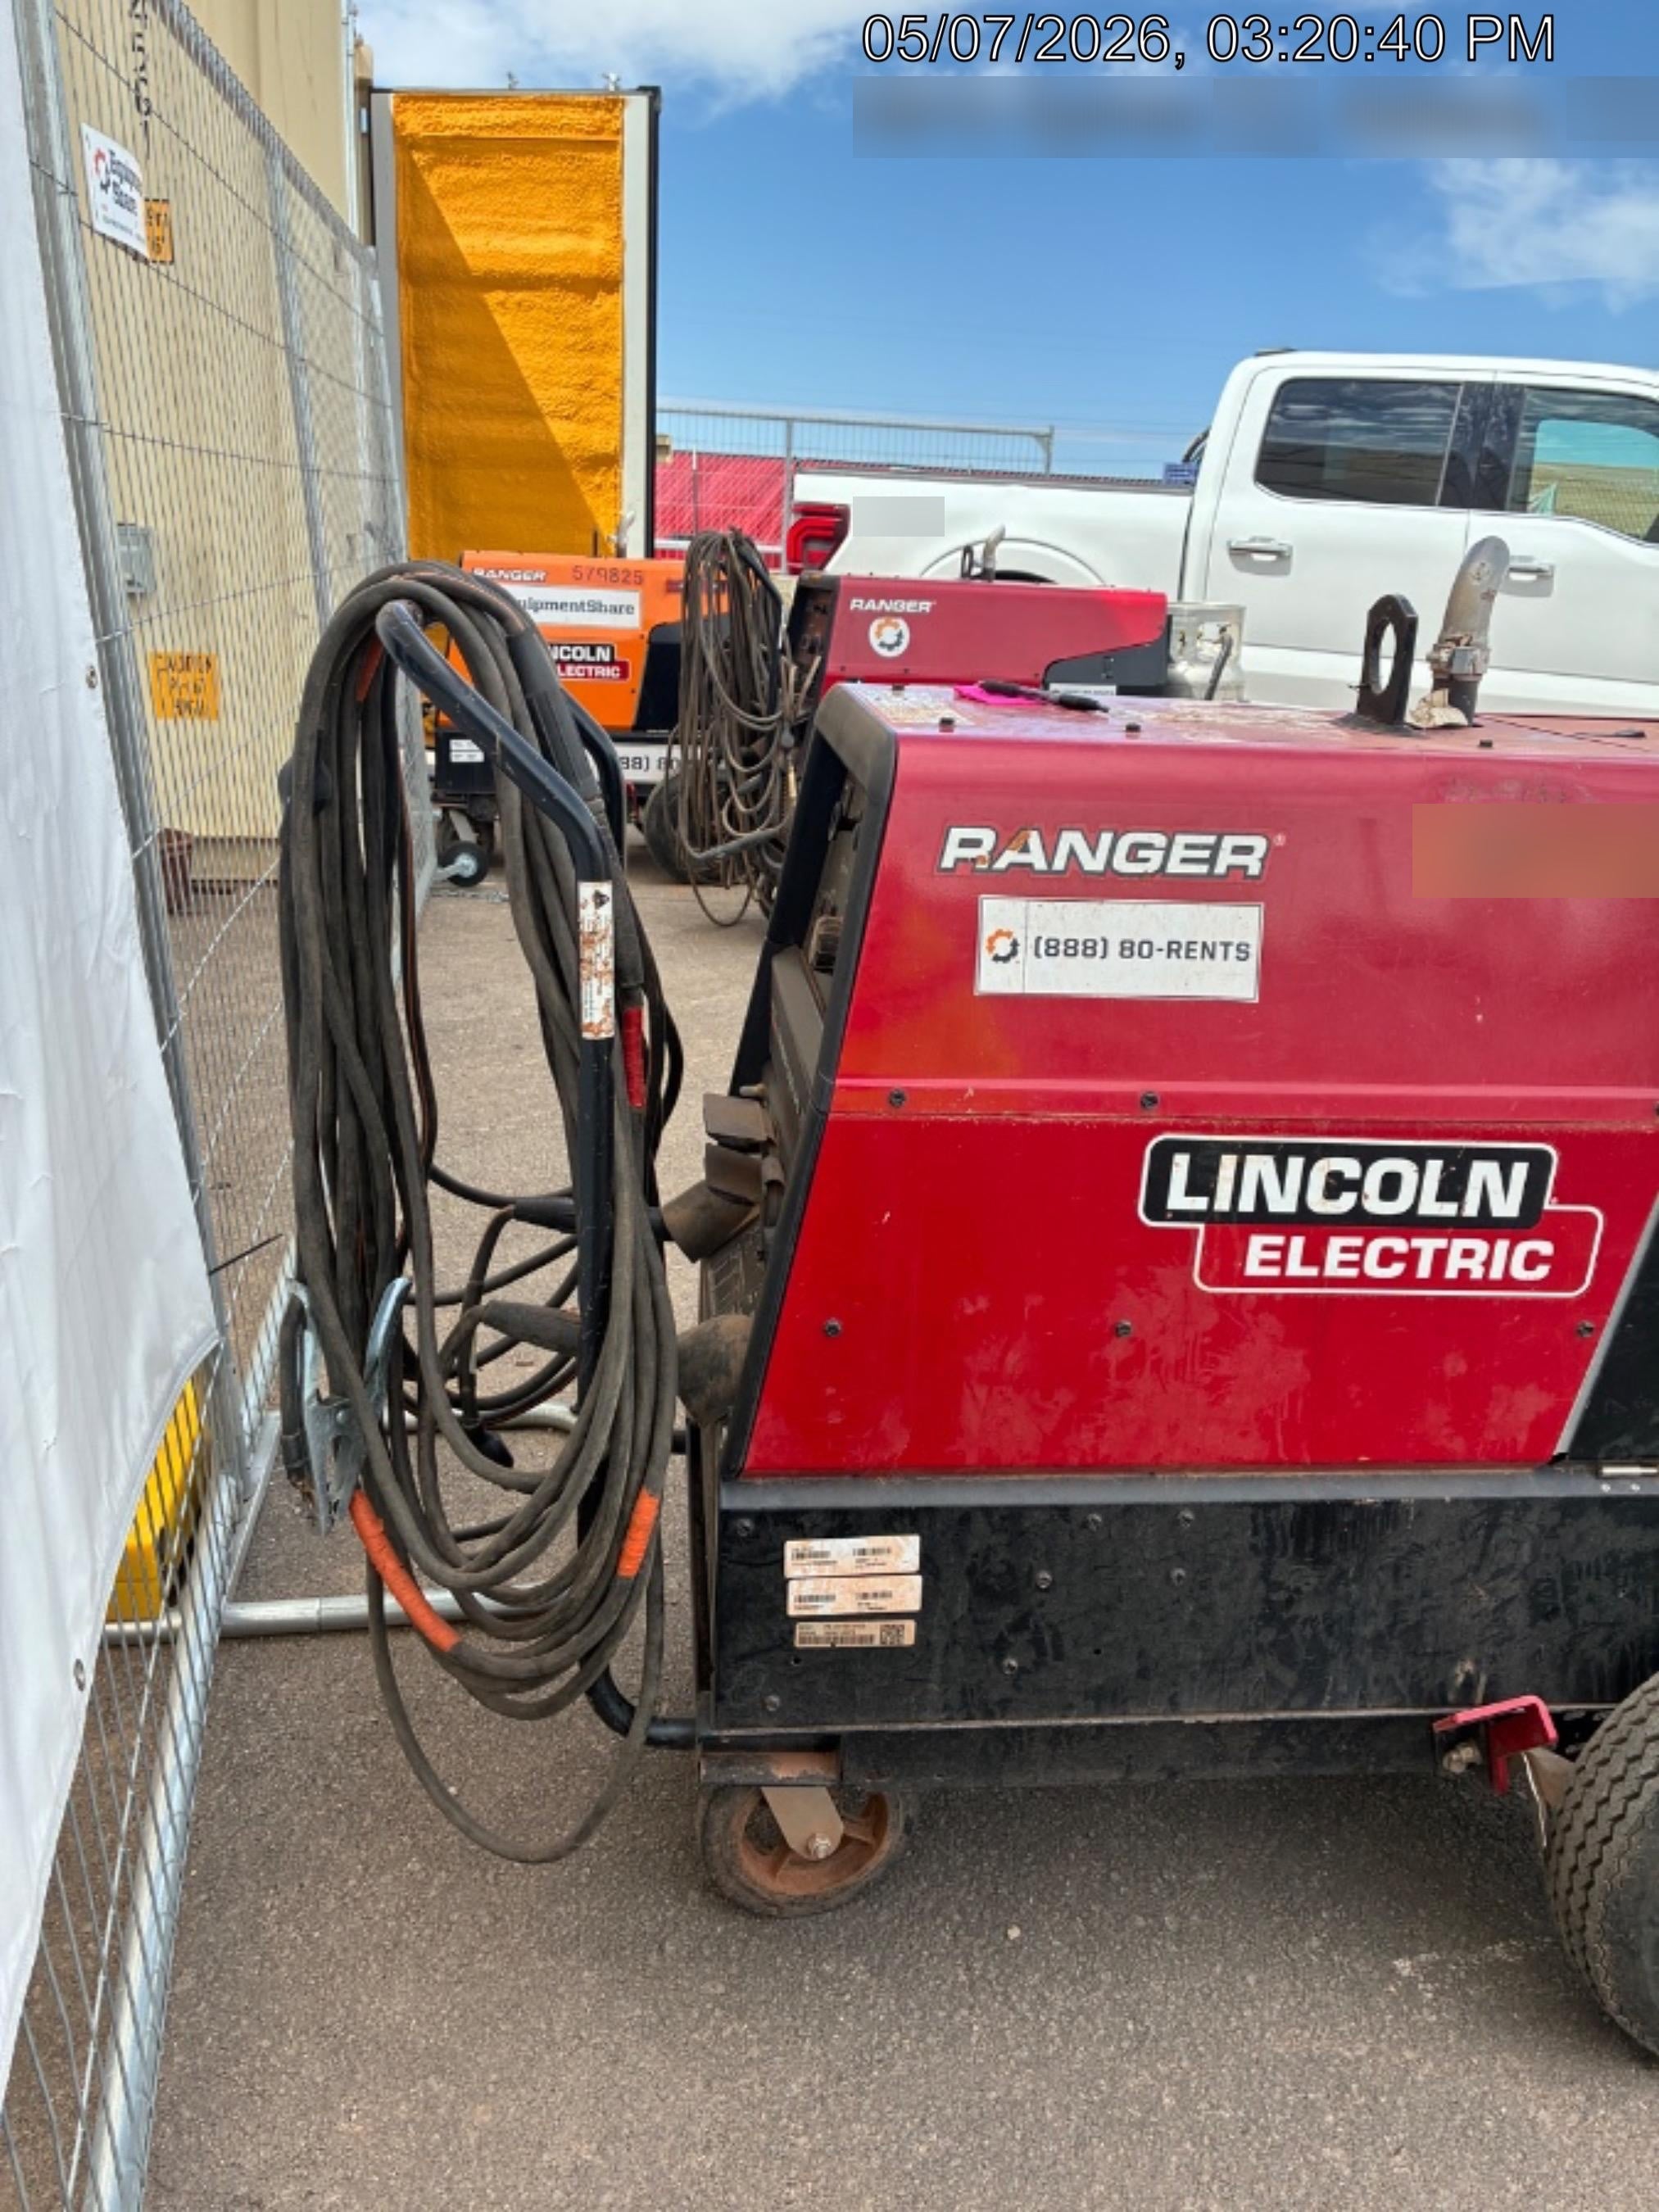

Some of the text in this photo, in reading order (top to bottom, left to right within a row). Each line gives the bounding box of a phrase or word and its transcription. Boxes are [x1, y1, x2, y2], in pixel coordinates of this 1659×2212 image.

[518, 597, 635, 615] uipmentShare
[850, 598, 931, 614] RANGER
[550, 645, 611, 662] NCOLN
[557, 662, 620, 678] LECTRIC
[938, 825, 1270, 878] RANGER
[1033, 936, 1251, 962] (888) 80-RENTS
[1165, 1152, 1530, 1218] LINCOLN
[1244, 1235, 1555, 1281] ELECTRIC
